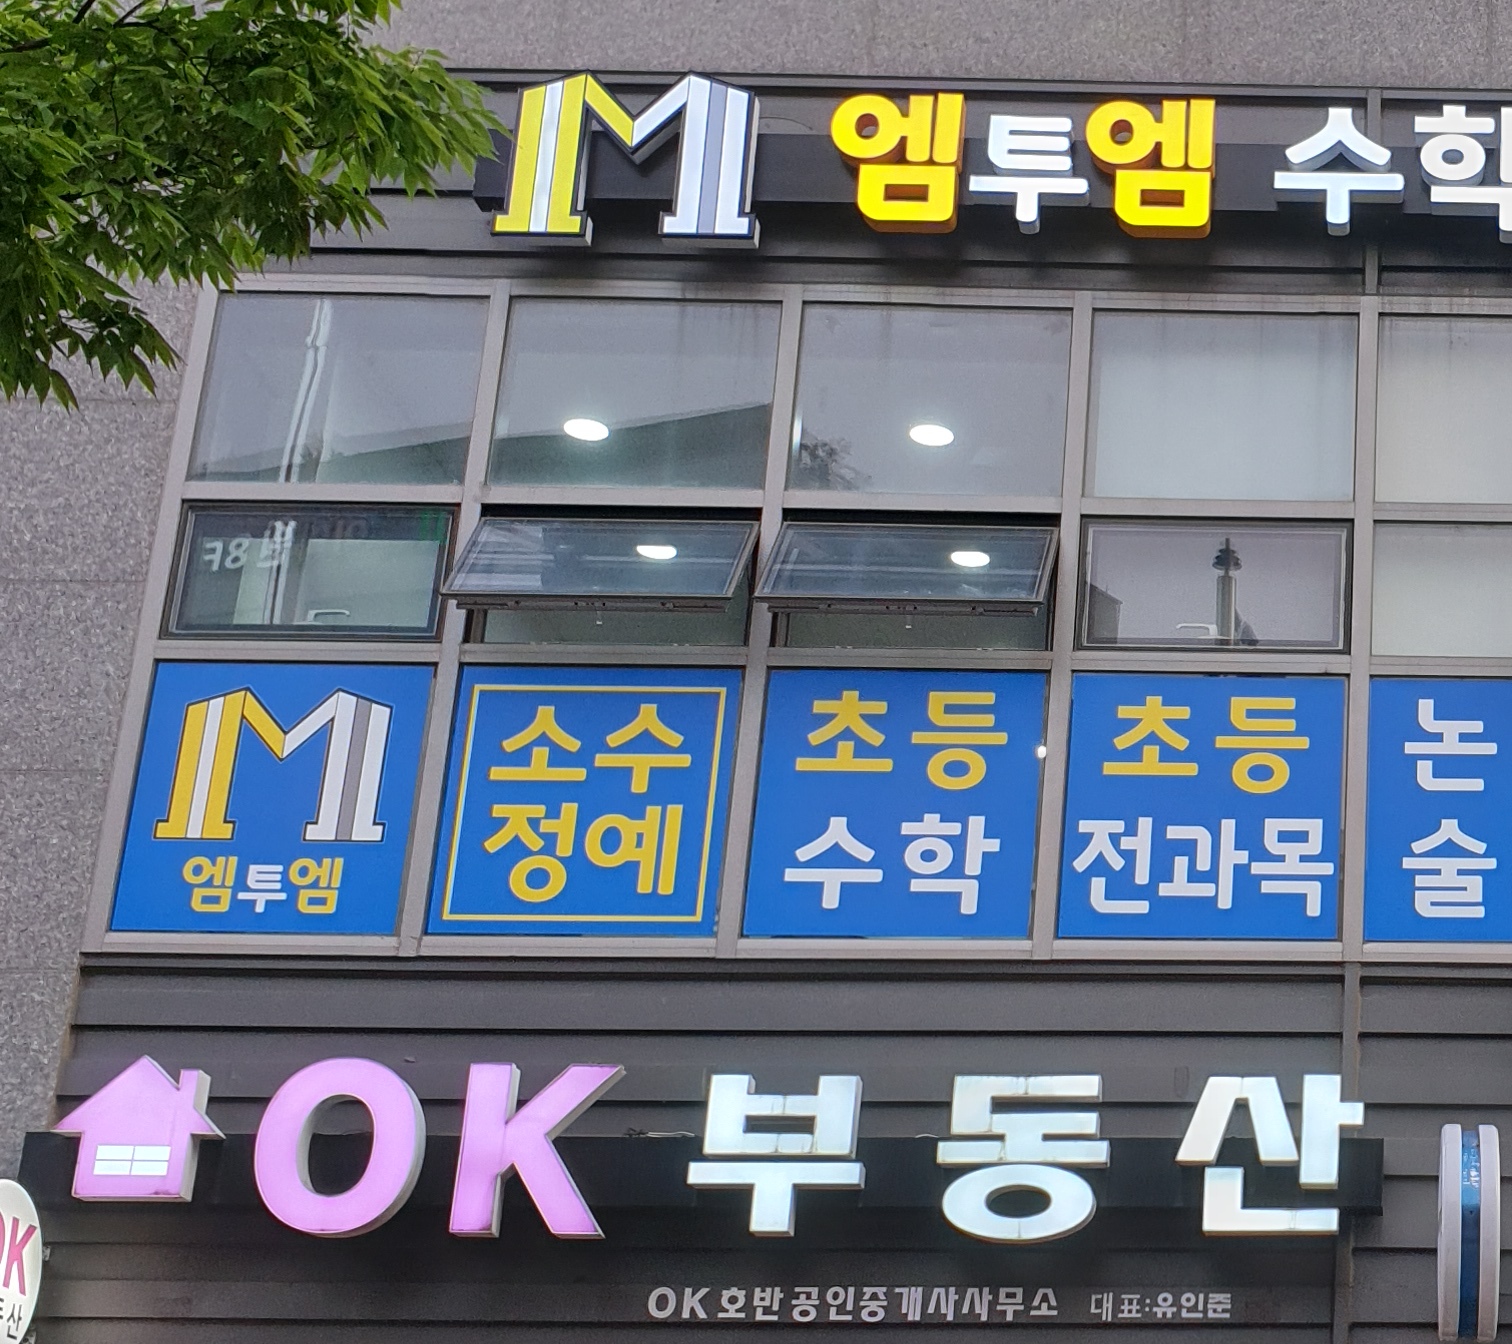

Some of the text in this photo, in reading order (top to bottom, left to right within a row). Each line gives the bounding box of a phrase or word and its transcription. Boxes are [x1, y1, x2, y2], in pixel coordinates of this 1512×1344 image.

[830, 92, 1216, 238] 엠투엠
[488, 703, 692, 794] 소수
[795, 690, 1009, 790] 초등
[1103, 696, 1310, 794] 초등
[182, 855, 344, 914] 엠투엠
[483, 802, 684, 904] 정예
[784, 813, 1001, 916] 수학
[1072, 816, 1335, 918] 전과목
[254, 1056, 1365, 1245] OK 부동산
[646, 1286, 710, 1320] OK
[718, 1285, 781, 1321] 호반
[791, 1285, 1059, 1322] 공인중개사사무소
